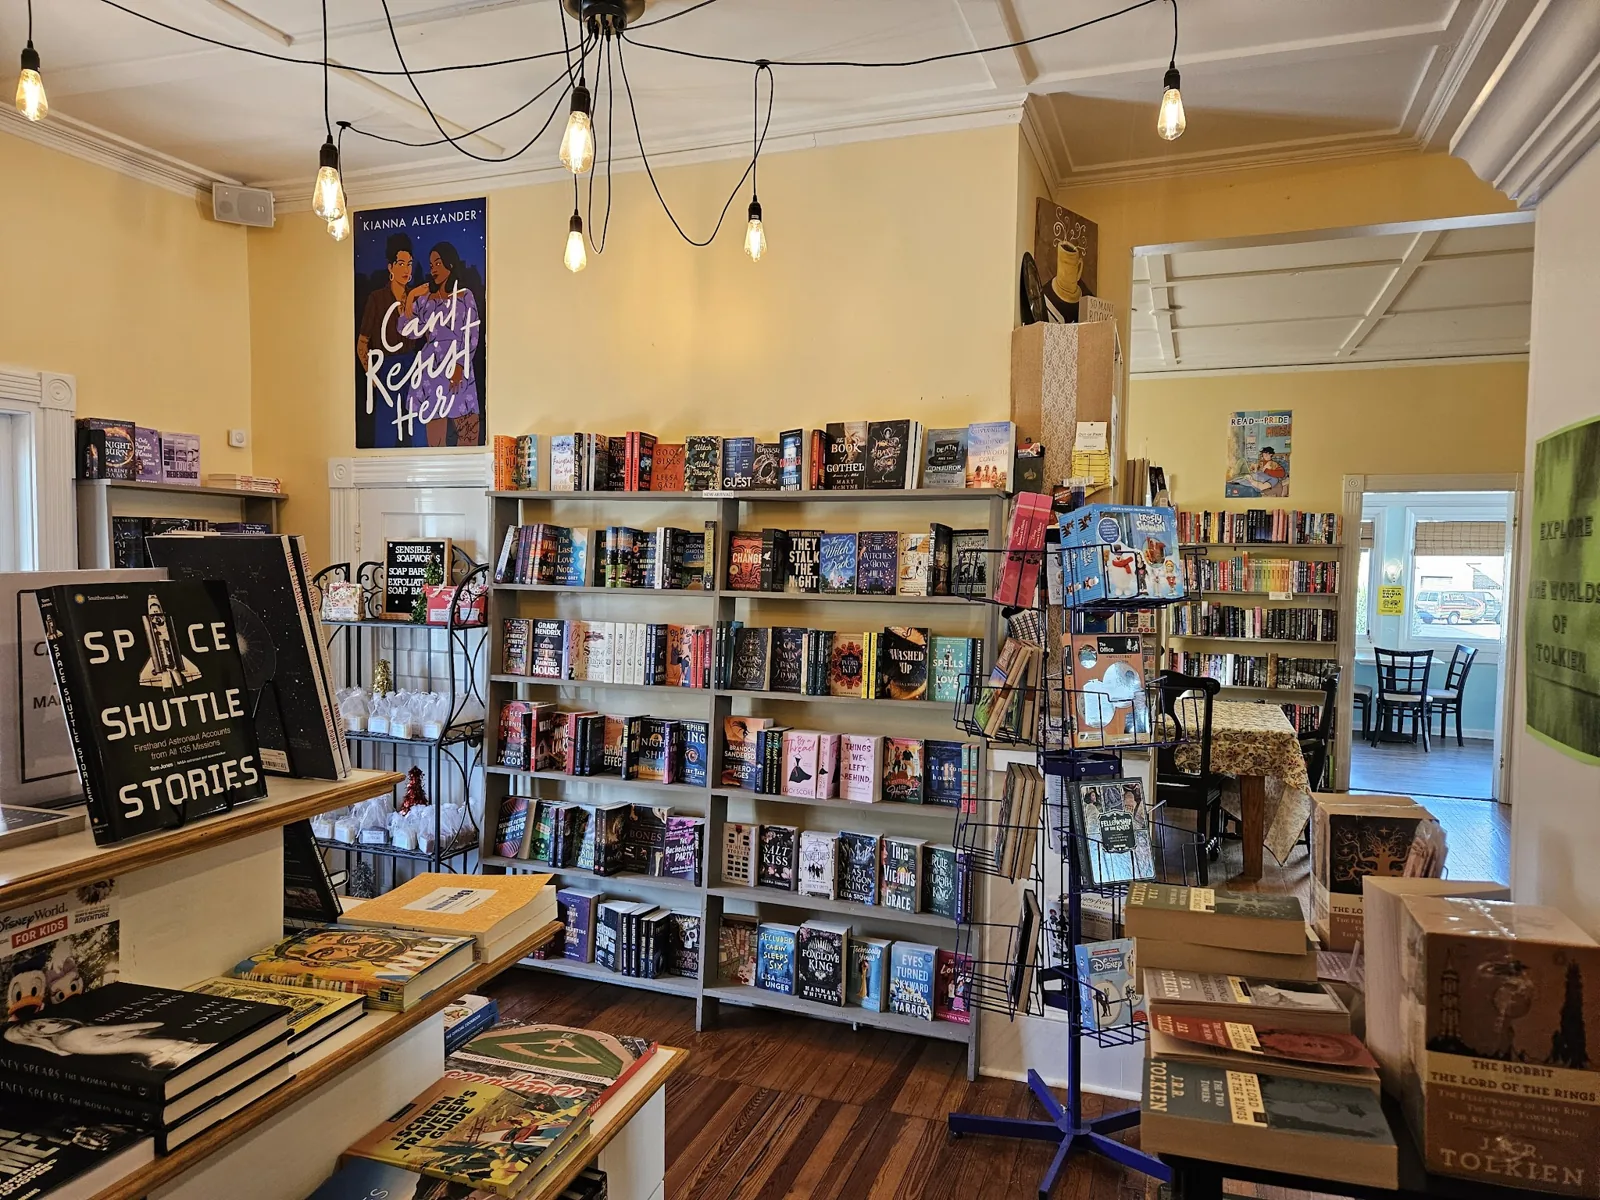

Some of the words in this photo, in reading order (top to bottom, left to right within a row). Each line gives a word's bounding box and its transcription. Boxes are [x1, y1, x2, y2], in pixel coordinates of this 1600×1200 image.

[363, 218, 406, 231] KIANNA
[412, 210, 477, 226] ALEXANDER
[381, 280, 467, 352] Can't
[366, 308, 481, 414] Resist
[392, 385, 455, 441] Her
[1231, 418, 1255, 426] READ
[1264, 416, 1288, 424] PRIDE
[694, 443, 713, 451] Witch
[831, 443, 862, 453] BOOK
[936, 444, 957, 453] DEATH
[826, 463, 865, 472] GOTHEL
[657, 482, 677, 490] GAZI
[723, 477, 752, 488] GUEST
[1539, 515, 1593, 541] EXPLORE
[559, 536, 569, 544] The
[791, 538, 817, 550] THEY
[395, 545, 432, 554] SENSIBLE
[558, 545, 574, 553] Last
[732, 553, 762, 564] CHANGE
[788, 551, 820, 563] STALK
[388, 568, 408, 576] SOAP
[556, 564, 574, 573] Note
[794, 563, 813, 575] THE
[387, 587, 408, 595] SOAP
[1550, 580, 1600, 604] WORLDS
[1552, 615, 1568, 634] OF
[534, 627, 561, 636] HENDRIX
[890, 648, 924, 661] WASHED
[1535, 643, 1587, 674] TOLKIEN
[53, 643, 67, 683] SPACE
[899, 663, 913, 675] UP
[932, 659, 964, 668] SPELLS
[532, 665, 560, 676] HOUSE
[935, 676, 959, 685] LOVE
[63, 687, 80, 743] SHUTTLE
[101, 688, 245, 741] SHUTTLE
[650, 725, 665, 733] THE
[133, 740, 167, 752] Firsthand
[168, 733, 201, 746] Astronaut
[201, 727, 231, 739] Accounts
[680, 731, 706, 743] KING
[151, 751, 168, 760] from
[169, 748, 177, 756] All
[179, 744, 191, 754] 135
[192, 739, 221, 751] Missions
[729, 744, 756, 752] BRANDON
[845, 743, 872, 753] THINGS
[497, 757, 522, 765] JACOB
[724, 751, 756, 761] SANDERSO
[160, 762, 173, 770] Jones
[76, 747, 94, 803] STORIES
[732, 772, 749, 780] AGES
[844, 775, 870, 783] BEHIND
[118, 755, 258, 819] STORIES
[782, 786, 795, 794] LUCY
[796, 787, 814, 796] SCORE
[629, 829, 662, 842] BONES
[674, 852, 694, 862] PARTY
[762, 845, 790, 856] SALT
[891, 842, 909, 861] THIS
[763, 854, 788, 866] KISS
[883, 864, 916, 887] VICIOUS
[845, 881, 868, 893] KING
[886, 889, 911, 911] GRACE
[1332, 906, 1350, 914] THE
[74, 911, 110, 925] ADVENTURE
[15, 931, 37, 946] FOR
[39, 920, 65, 936] KIDS
[760, 932, 794, 945] SECLUDED
[765, 943, 787, 951] CABIN
[375, 934, 467, 980] WILL
[763, 951, 789, 964] SLEEPS
[802, 949, 840, 964] FOXGLOVE
[901, 954, 924, 968] EYES
[676, 961, 699, 970] FEARED
[769, 960, 784, 971] SIX
[808, 959, 834, 972] KING
[1090, 958, 1123, 972] Disney
[761, 973, 776, 981] LISA
[896, 966, 929, 982] TURNED
[242, 970, 268, 983] WILL
[269, 974, 304, 987] SMITH
[313, 979, 359, 995] WILL
[765, 980, 790, 992] UNGER
[895, 979, 929, 993] SKYWARD
[803, 990, 838, 1002] WHITTEN
[804, 985, 837, 996] HANNAH
[898, 992, 929, 1005] REBECCA
[95, 991, 164, 1023] BRITNEY
[125, 994, 185, 1021] SPEARS
[194, 999, 223, 1012] THE
[894, 1001, 929, 1017] YARROS
[181, 1002, 239, 1029] WOMAN
[214, 1015, 233, 1025] IN
[234, 1005, 257, 1016] ME
[23, 1063, 60, 1079] SPEARS
[1471, 1059, 1499, 1072] THE
[1502, 1062, 1554, 1079] HOBBIT
[1230, 1073, 1241, 1081] OF
[1243, 1075, 1256, 1087] THE
[1149, 1061, 1168, 1112] TOLKIEN
[1200, 1079, 1211, 1104] TOWERS
[1213, 1080, 1223, 1091] THE
[1232, 1082, 1244, 1096] THE
[1430, 1071, 1457, 1083] THE
[1461, 1075, 1498, 1090] LORD
[1500, 1080, 1519, 1092] OF
[1523, 1084, 1550, 1097] THE
[1554, 1089, 1597, 1103] RINGS
[28, 1086, 65, 1103] SPEARS
[1215, 1091, 1225, 1107] TWO
[1246, 1087, 1260, 1108] LORD
[1234, 1096, 1249, 1121] RINGS
[393, 1090, 478, 1151] TRAVELER'S
[396, 1095, 456, 1138] SCREEN
[429, 1107, 475, 1139] GUIDE
[1440, 1147, 1586, 1187] TOLKIEN
